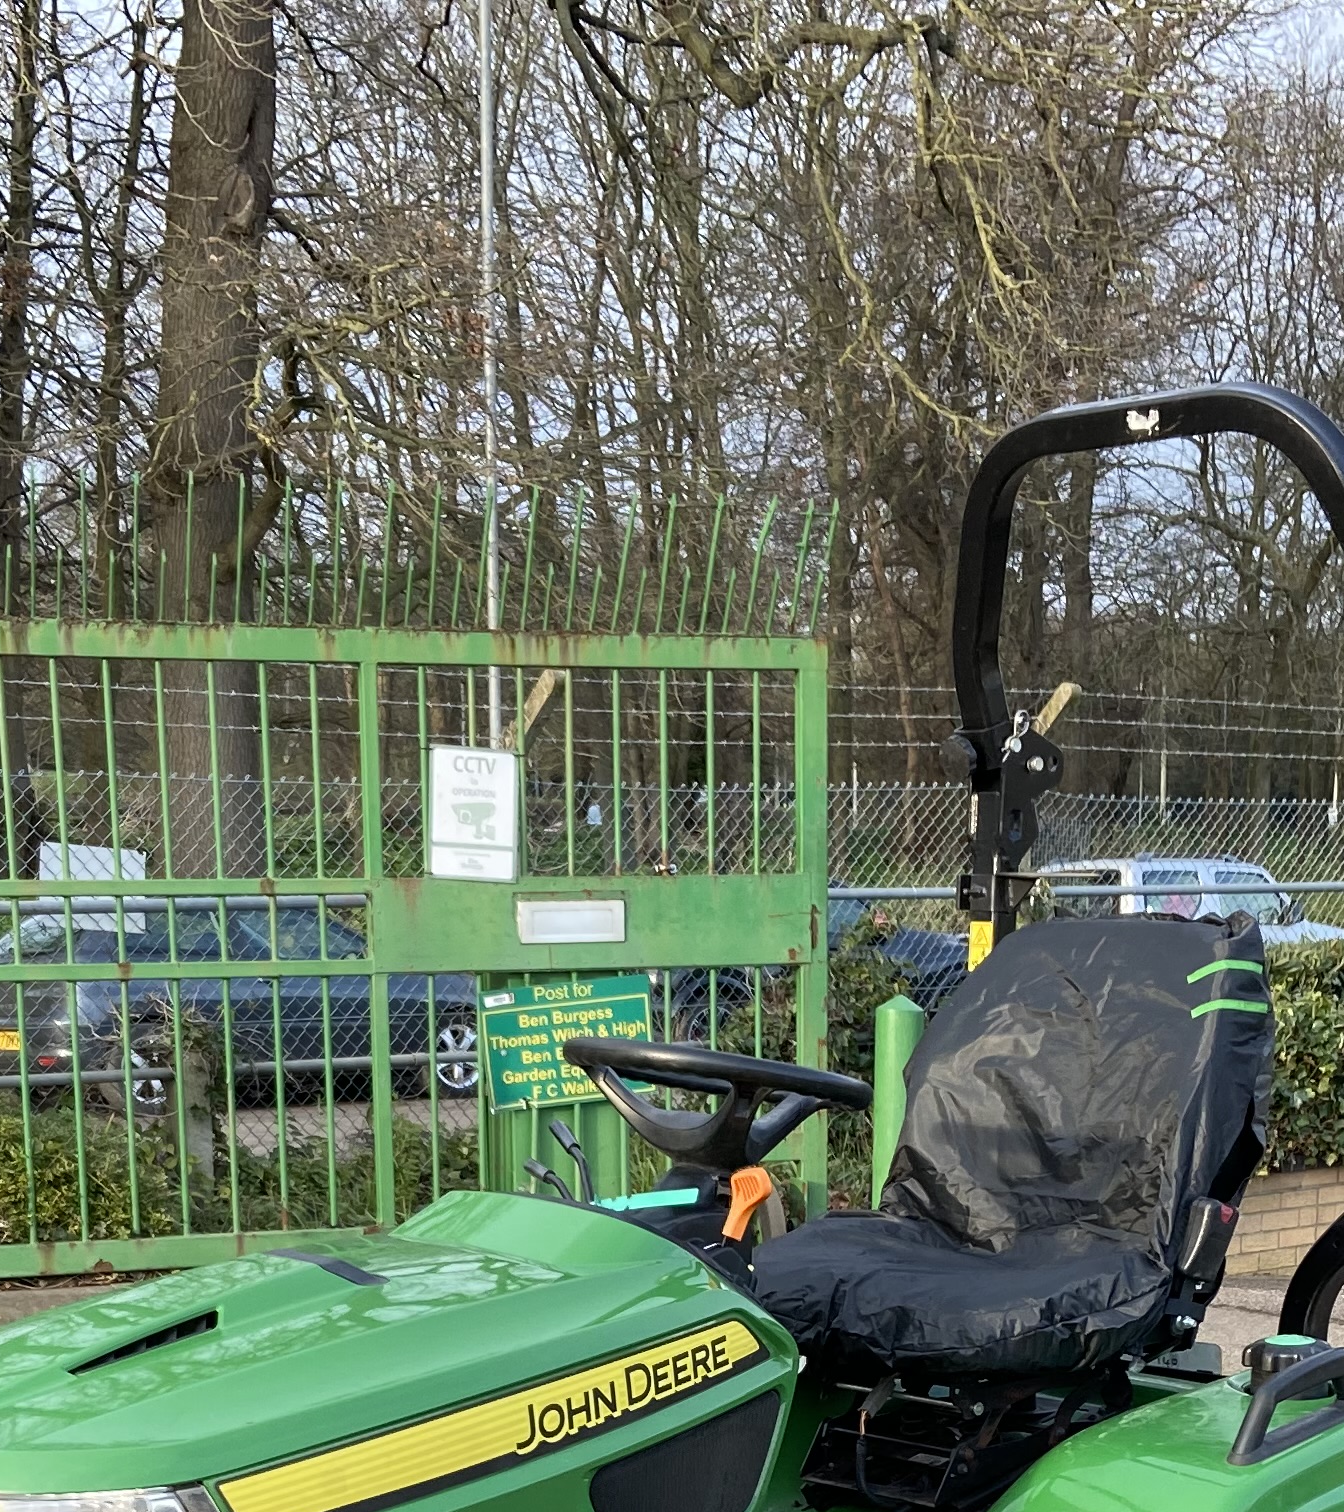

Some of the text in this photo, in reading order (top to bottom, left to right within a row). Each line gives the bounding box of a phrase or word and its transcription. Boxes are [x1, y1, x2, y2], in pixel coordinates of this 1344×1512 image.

[453, 755, 497, 775] CCTV
[452, 787, 497, 799] OPERATION
[533, 982, 595, 1002] Post for
[518, 1007, 614, 1029] Ben Burgess
[489, 1033, 549, 1051] Thomas
[597, 1024, 609, 1038] &
[612, 1020, 646, 1039] High
[521, 1050, 552, 1065] Ben
[502, 1067, 557, 1085] Garden
[532, 1079, 598, 1100] F C Walk
[516, 1335, 731, 1452] JOHN DEERE
